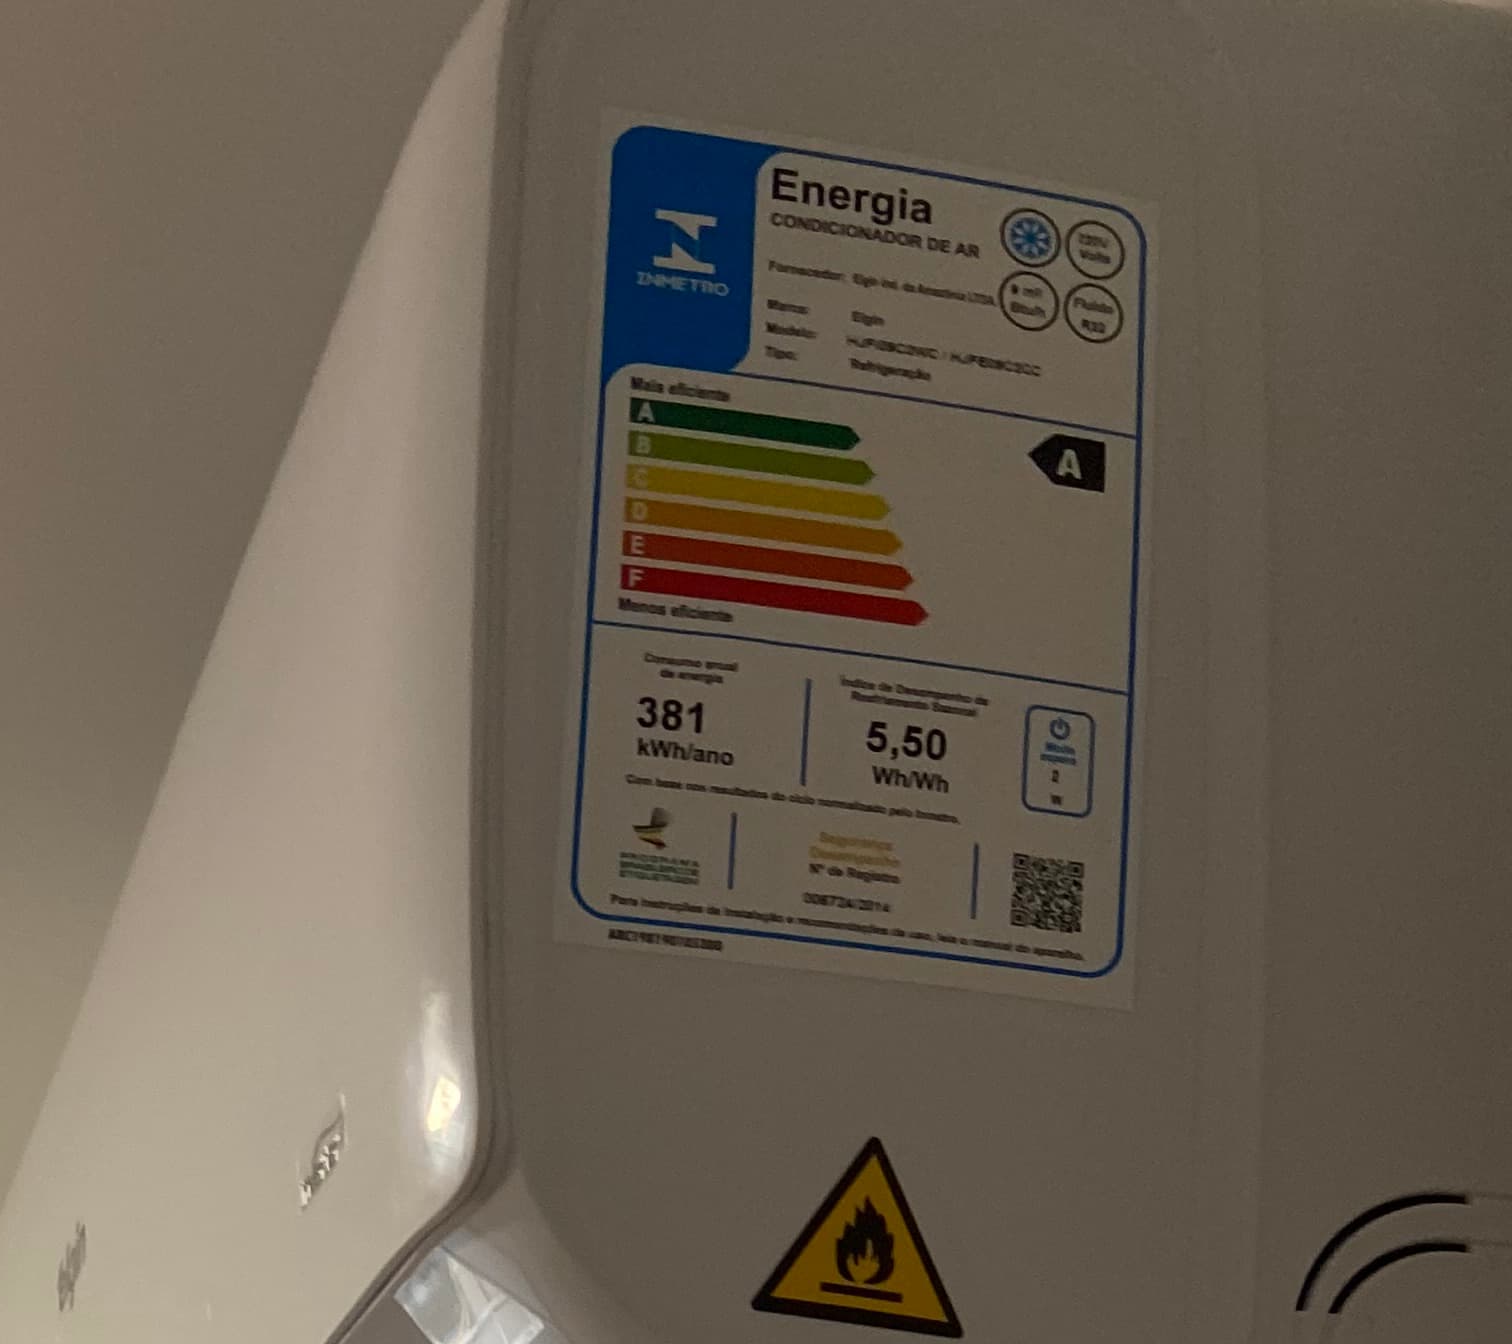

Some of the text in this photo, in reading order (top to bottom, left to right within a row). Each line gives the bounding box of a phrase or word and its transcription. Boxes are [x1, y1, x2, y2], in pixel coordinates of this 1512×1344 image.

[771, 168, 932, 225] Energia
[771, 213, 979, 258] CONDICIONADOR DE AR
[637, 271, 730, 297] INMETRO
[638, 402, 656, 423] A
[638, 435, 651, 455] B
[1055, 449, 1082, 479] A
[630, 534, 647, 555] E
[628, 568, 646, 588] F
[637, 697, 705, 733] 381
[637, 737, 735, 766] kWh/ano
[866, 721, 946, 760] 5,50
[872, 766, 949, 793] Wh/Wh
